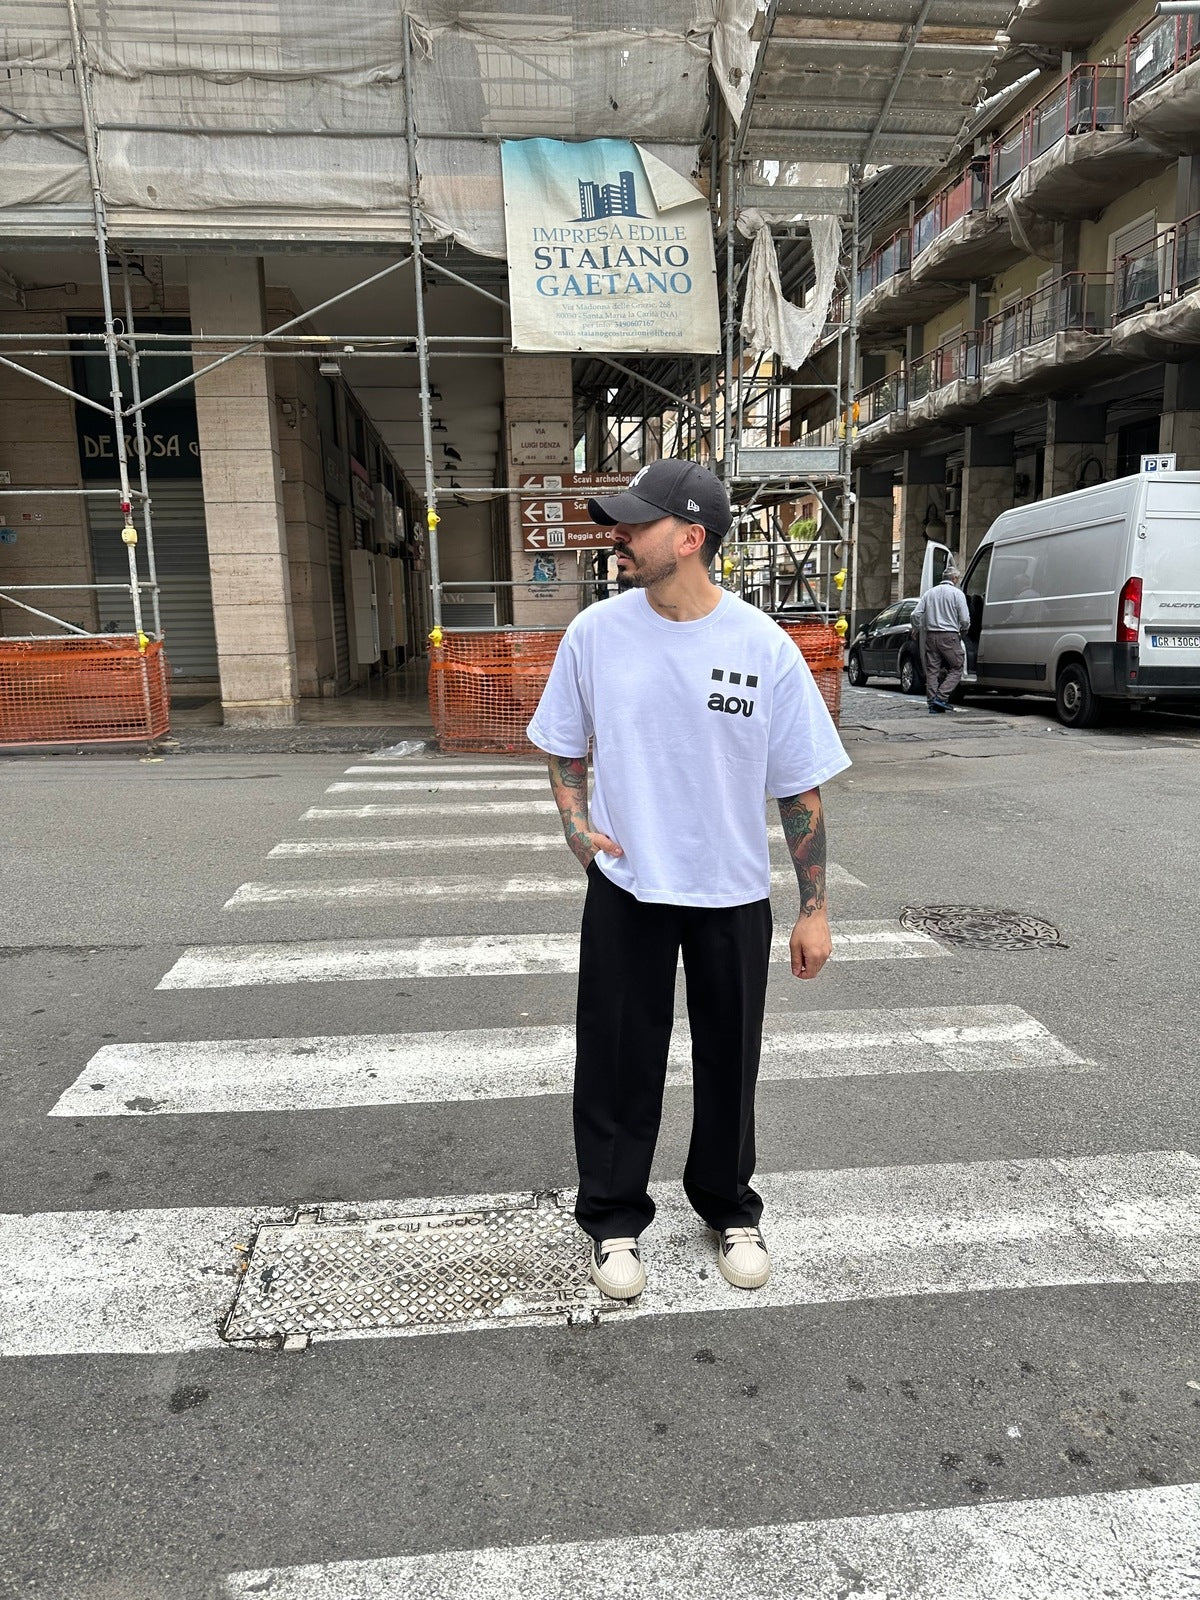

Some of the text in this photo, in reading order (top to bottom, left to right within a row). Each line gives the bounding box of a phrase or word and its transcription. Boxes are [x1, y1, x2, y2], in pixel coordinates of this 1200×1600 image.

[532, 223, 687, 244] IMPRESA EDILE
[533, 245, 690, 270] STAIANO
[535, 271, 693, 297] GAETANO
[562, 303, 574, 311] Via
[612, 302, 630, 310] delle
[604, 311, 626, 319] Maria
[660, 310, 678, 320] (NA)
[83, 434, 114, 458] DE
[123, 434, 181, 458] ROSA
[520, 441, 561, 449] LUIGI DENZA
[573, 475, 592, 484] Scavi
[567, 532, 593, 542] Reggia
[595, 531, 603, 539] di
[376, 1216, 481, 1233] open fiber
